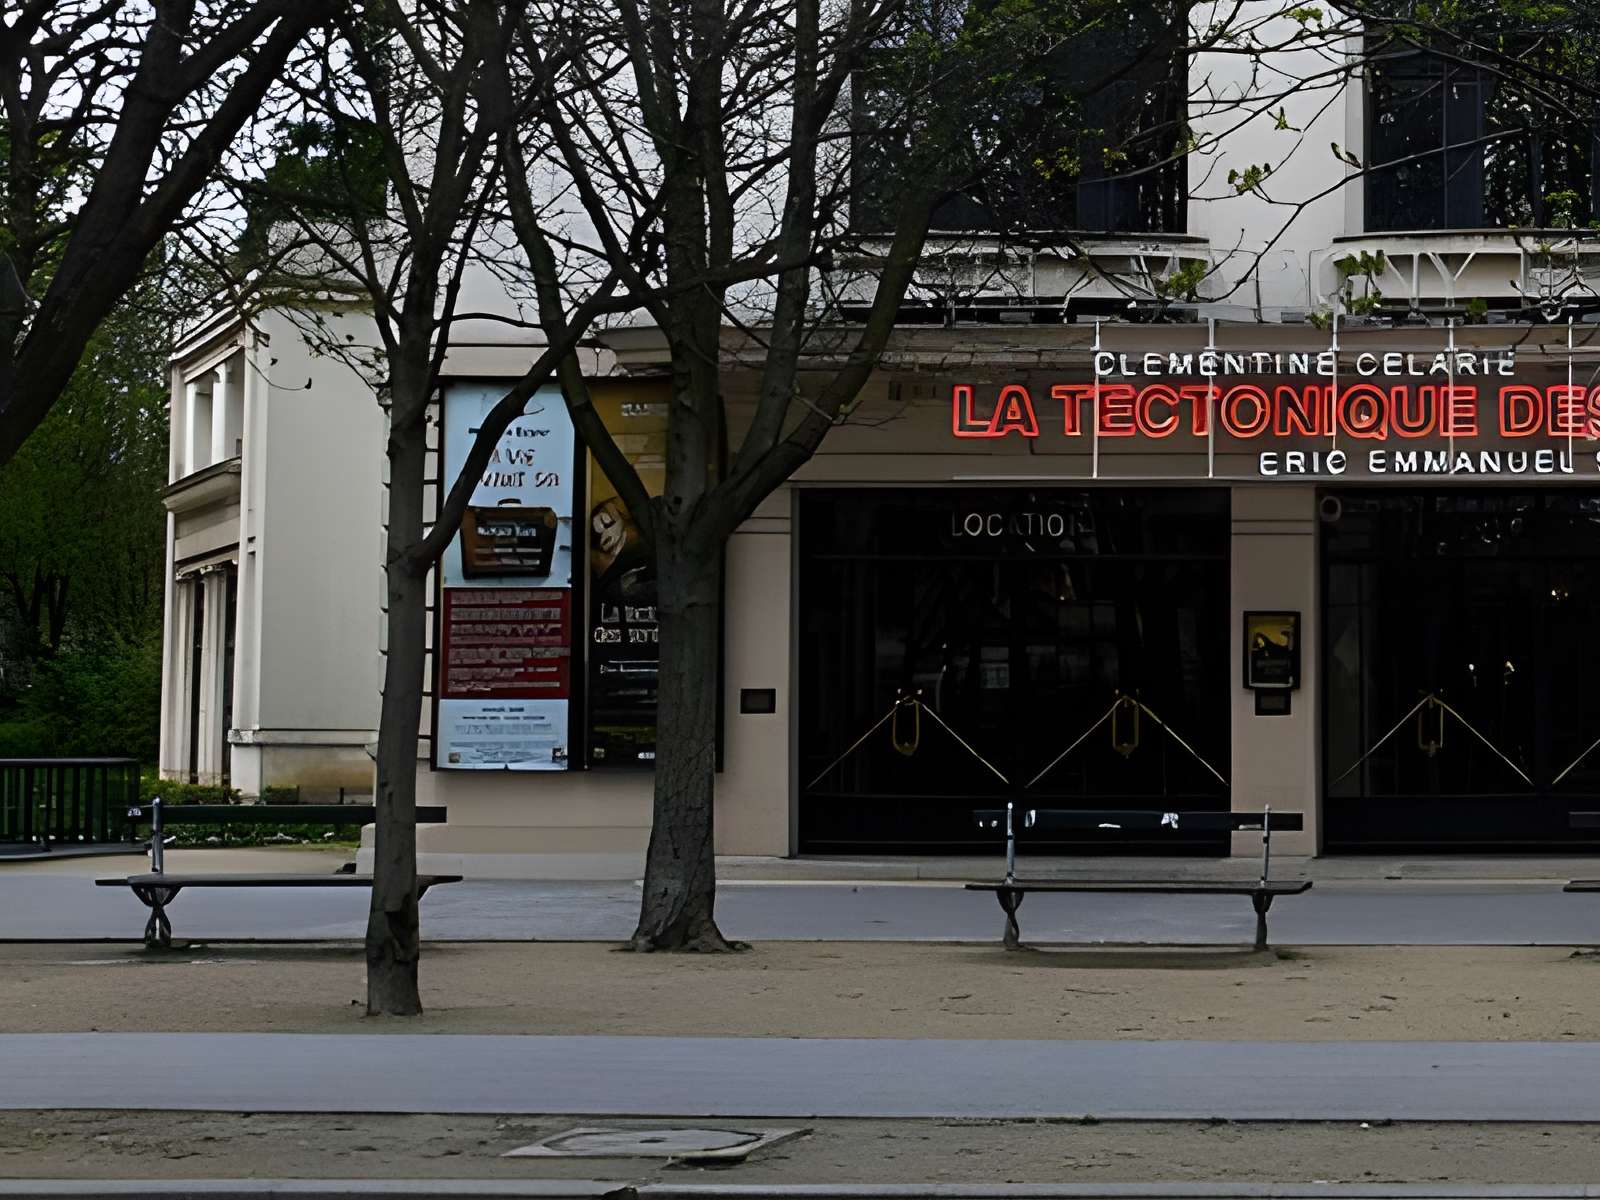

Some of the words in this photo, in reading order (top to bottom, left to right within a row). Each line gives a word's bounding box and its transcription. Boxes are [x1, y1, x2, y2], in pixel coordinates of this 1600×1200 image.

[1094, 351, 1335, 377] CLEMENTINE
[1356, 352, 1515, 376] CELARIE
[951, 383, 1040, 439] LA
[1051, 383, 1479, 441] TECTONIQUE
[1259, 450, 1347, 475] ERIC
[1368, 450, 1574, 474] EMMANUEL
